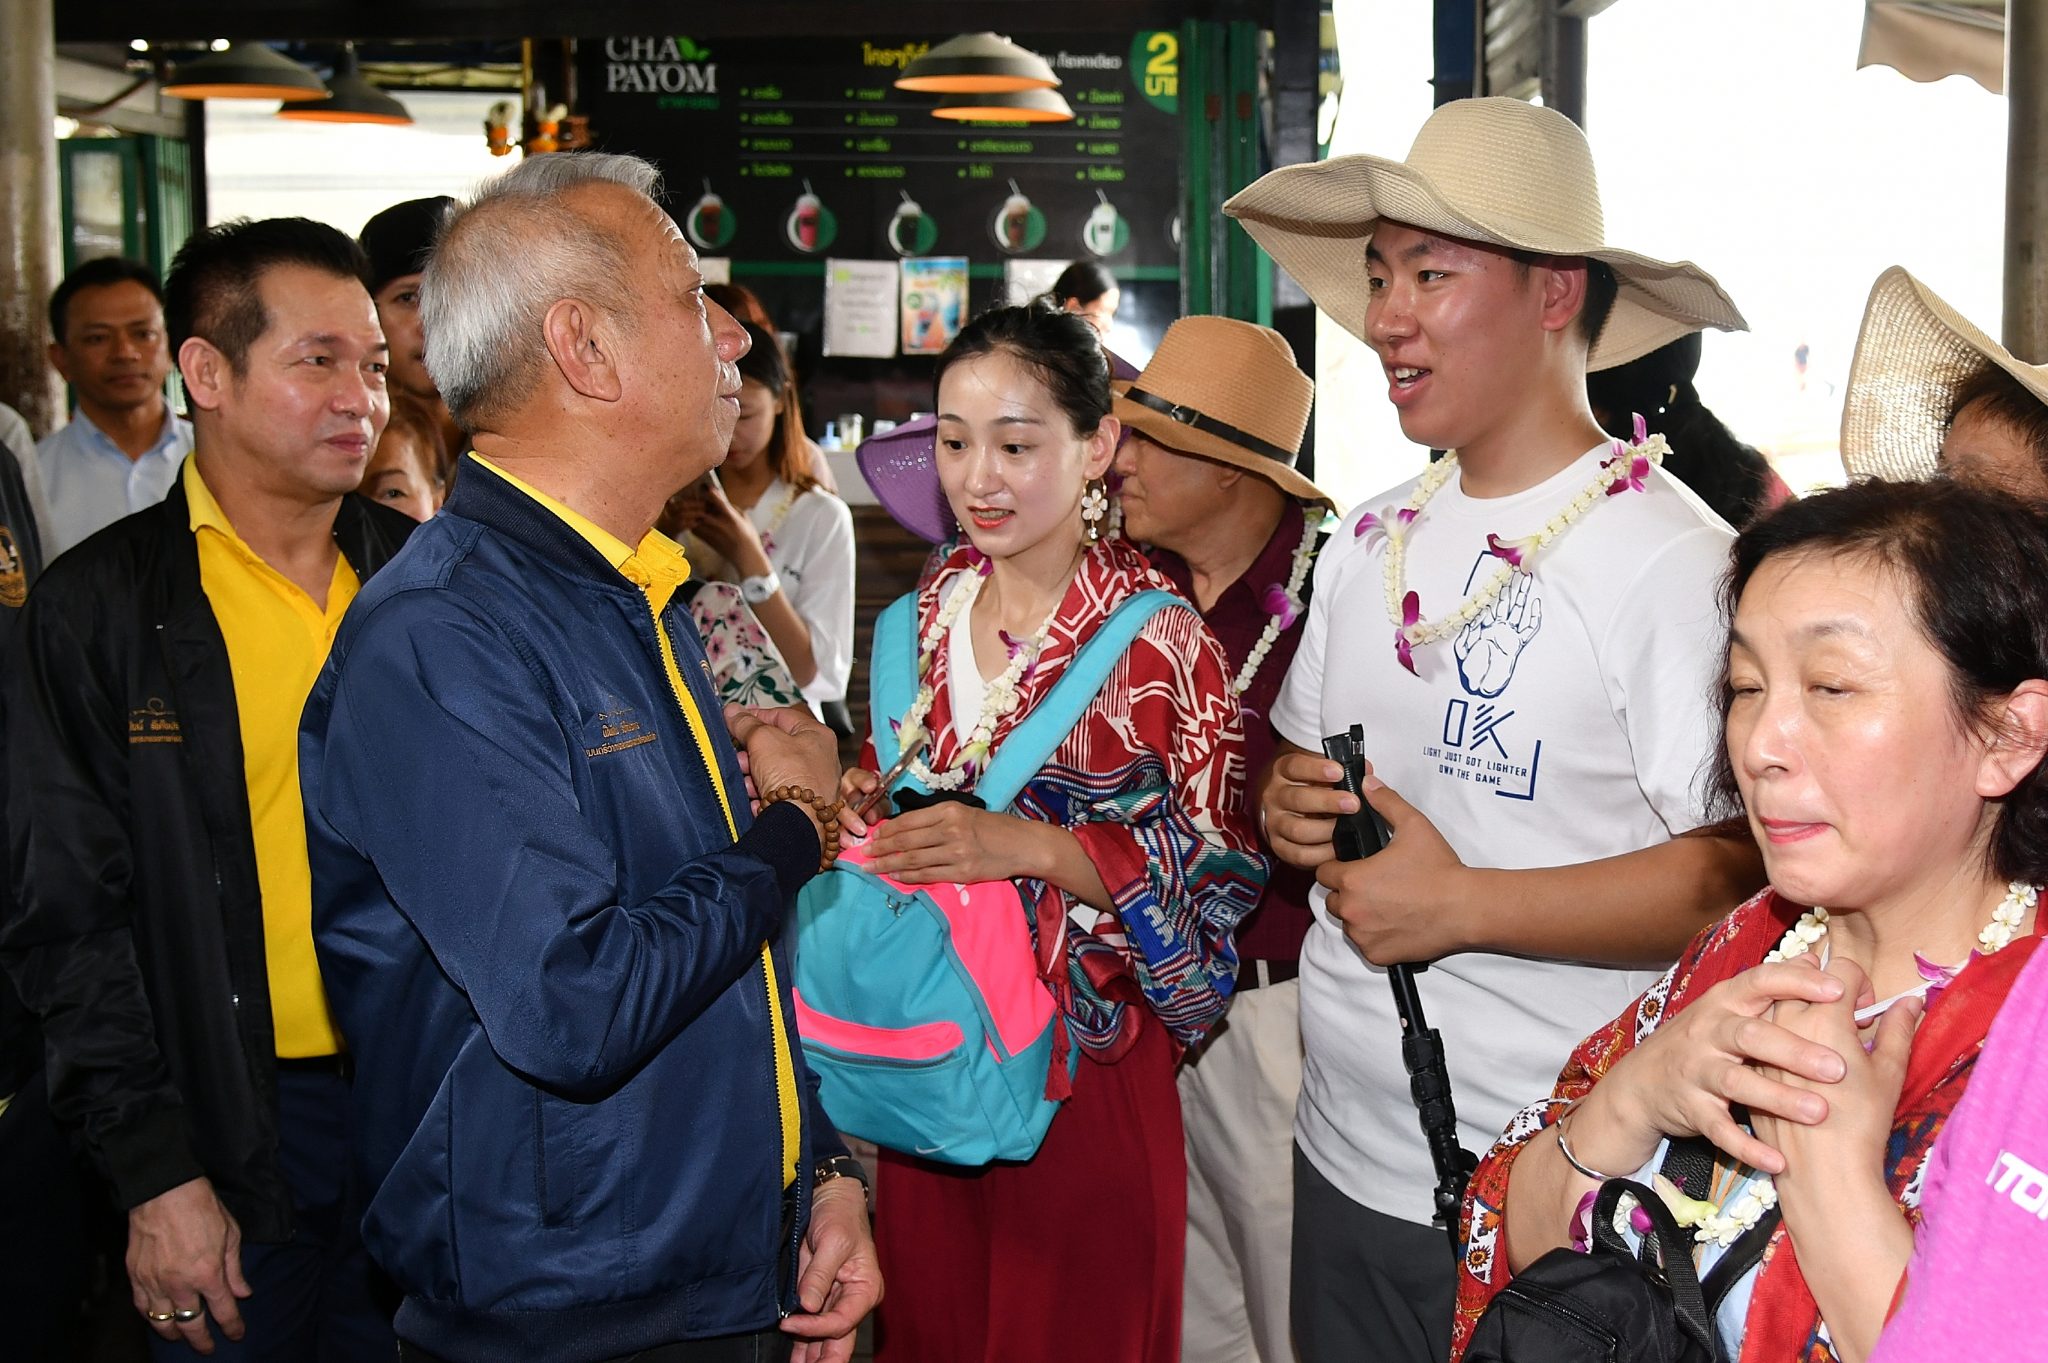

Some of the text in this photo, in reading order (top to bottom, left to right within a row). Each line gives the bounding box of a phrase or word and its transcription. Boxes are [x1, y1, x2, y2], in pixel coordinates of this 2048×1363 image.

[605, 36, 681, 61] CHA
[606, 62, 718, 93] PAYOM
[1423, 746, 1528, 777] LIGHT JUST GOT LIGHTER
[1439, 764, 1501, 786] OWN THE GAME
